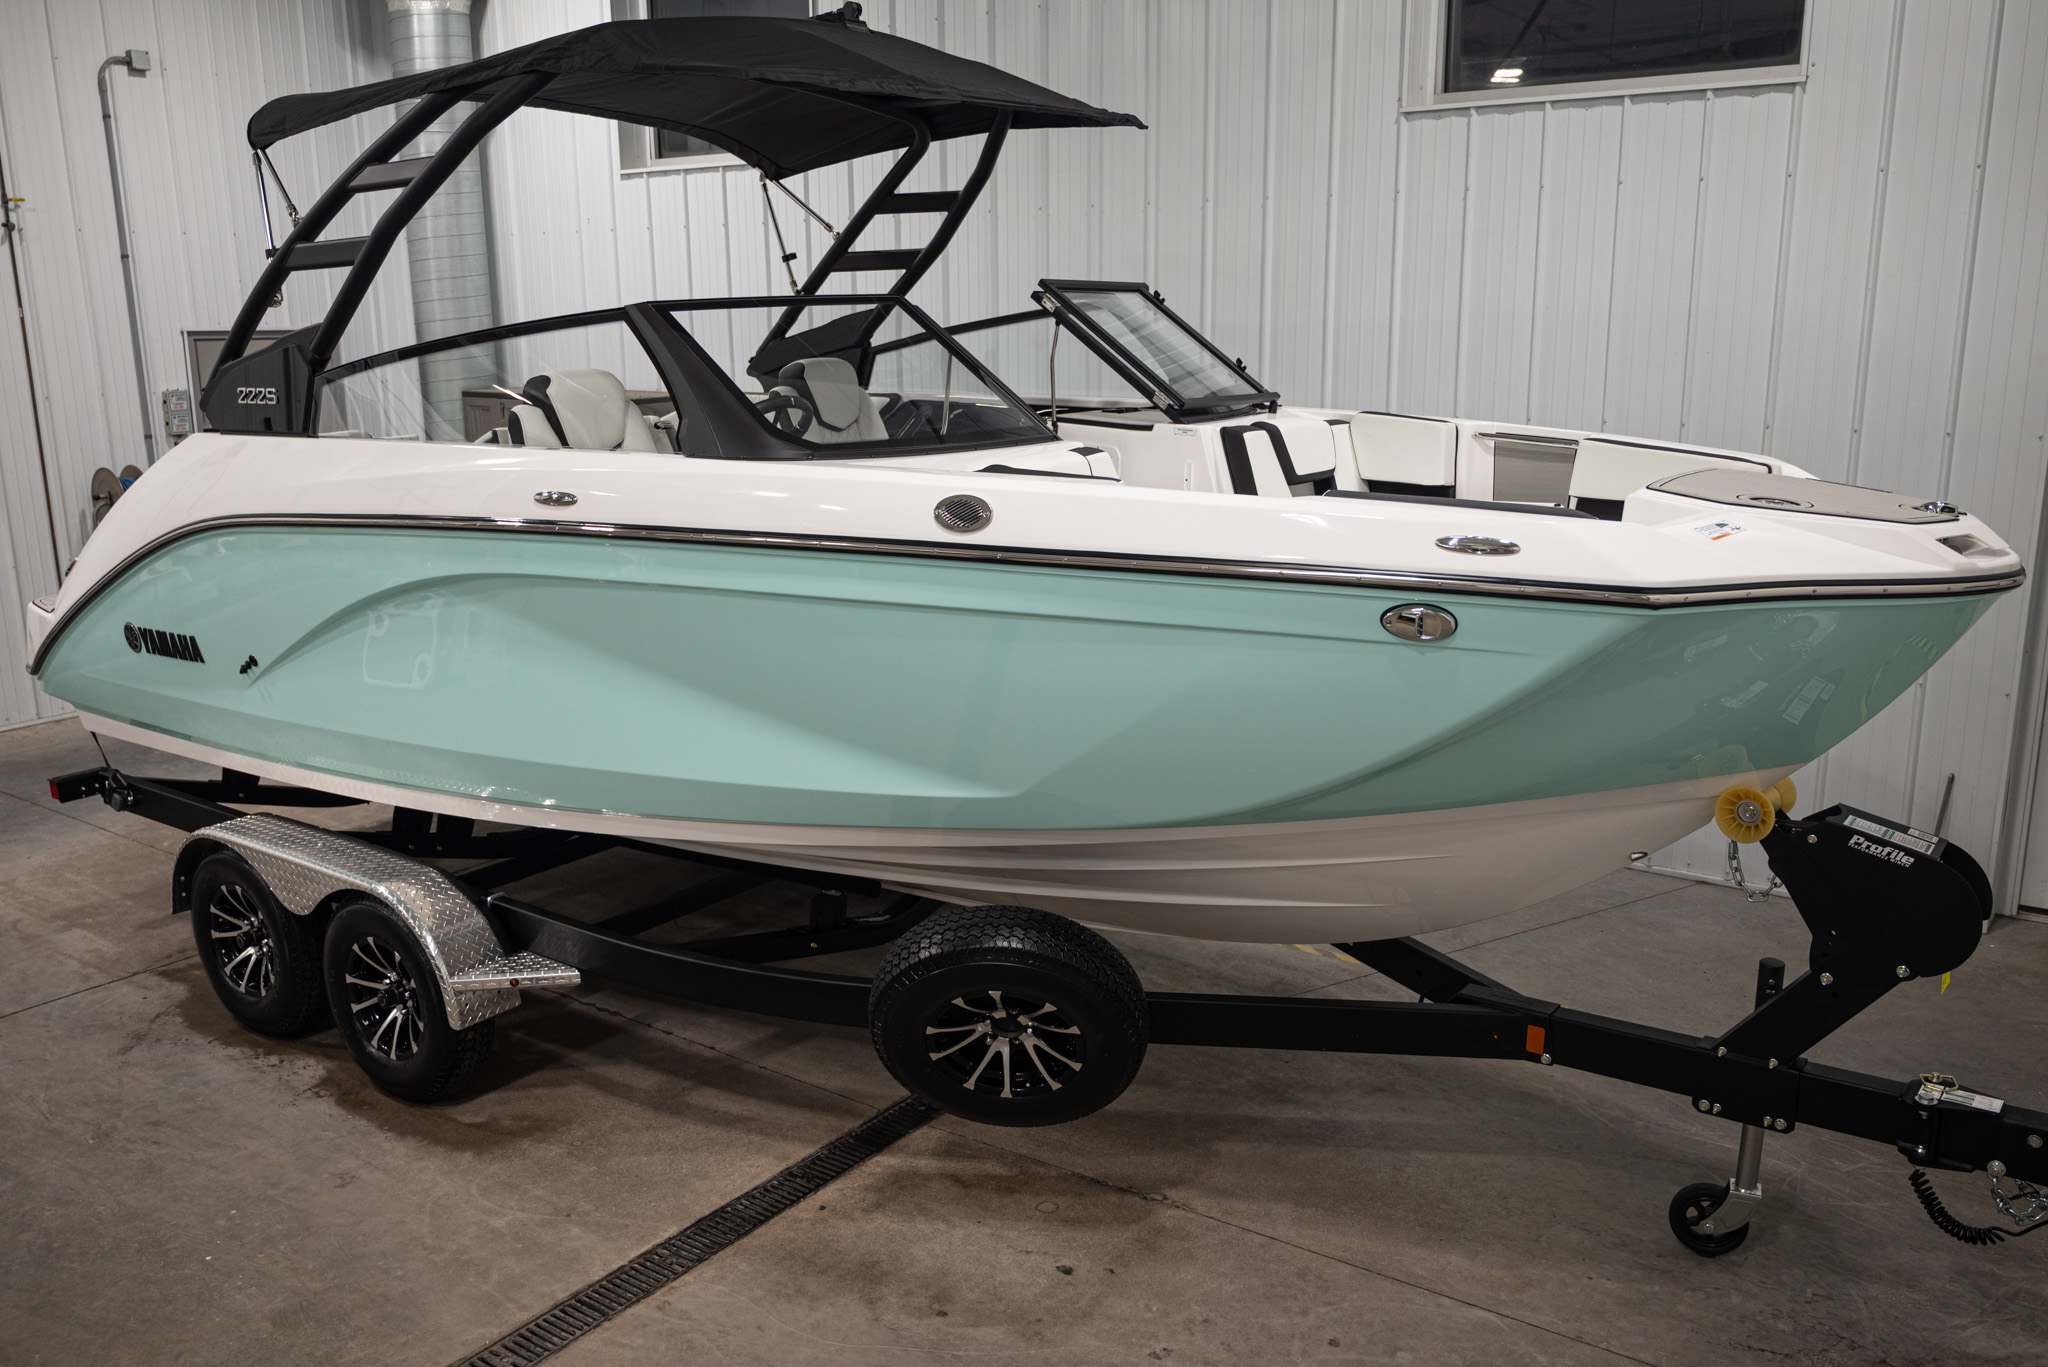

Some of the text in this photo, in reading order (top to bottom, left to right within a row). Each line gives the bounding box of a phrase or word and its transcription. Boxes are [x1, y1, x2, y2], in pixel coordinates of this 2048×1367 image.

[237, 387, 277, 405] 222S
[137, 626, 205, 664] YAMAHA
[1847, 842, 1910, 868] PERFORMANCE WINCH
[1849, 834, 1915, 865] Profile
